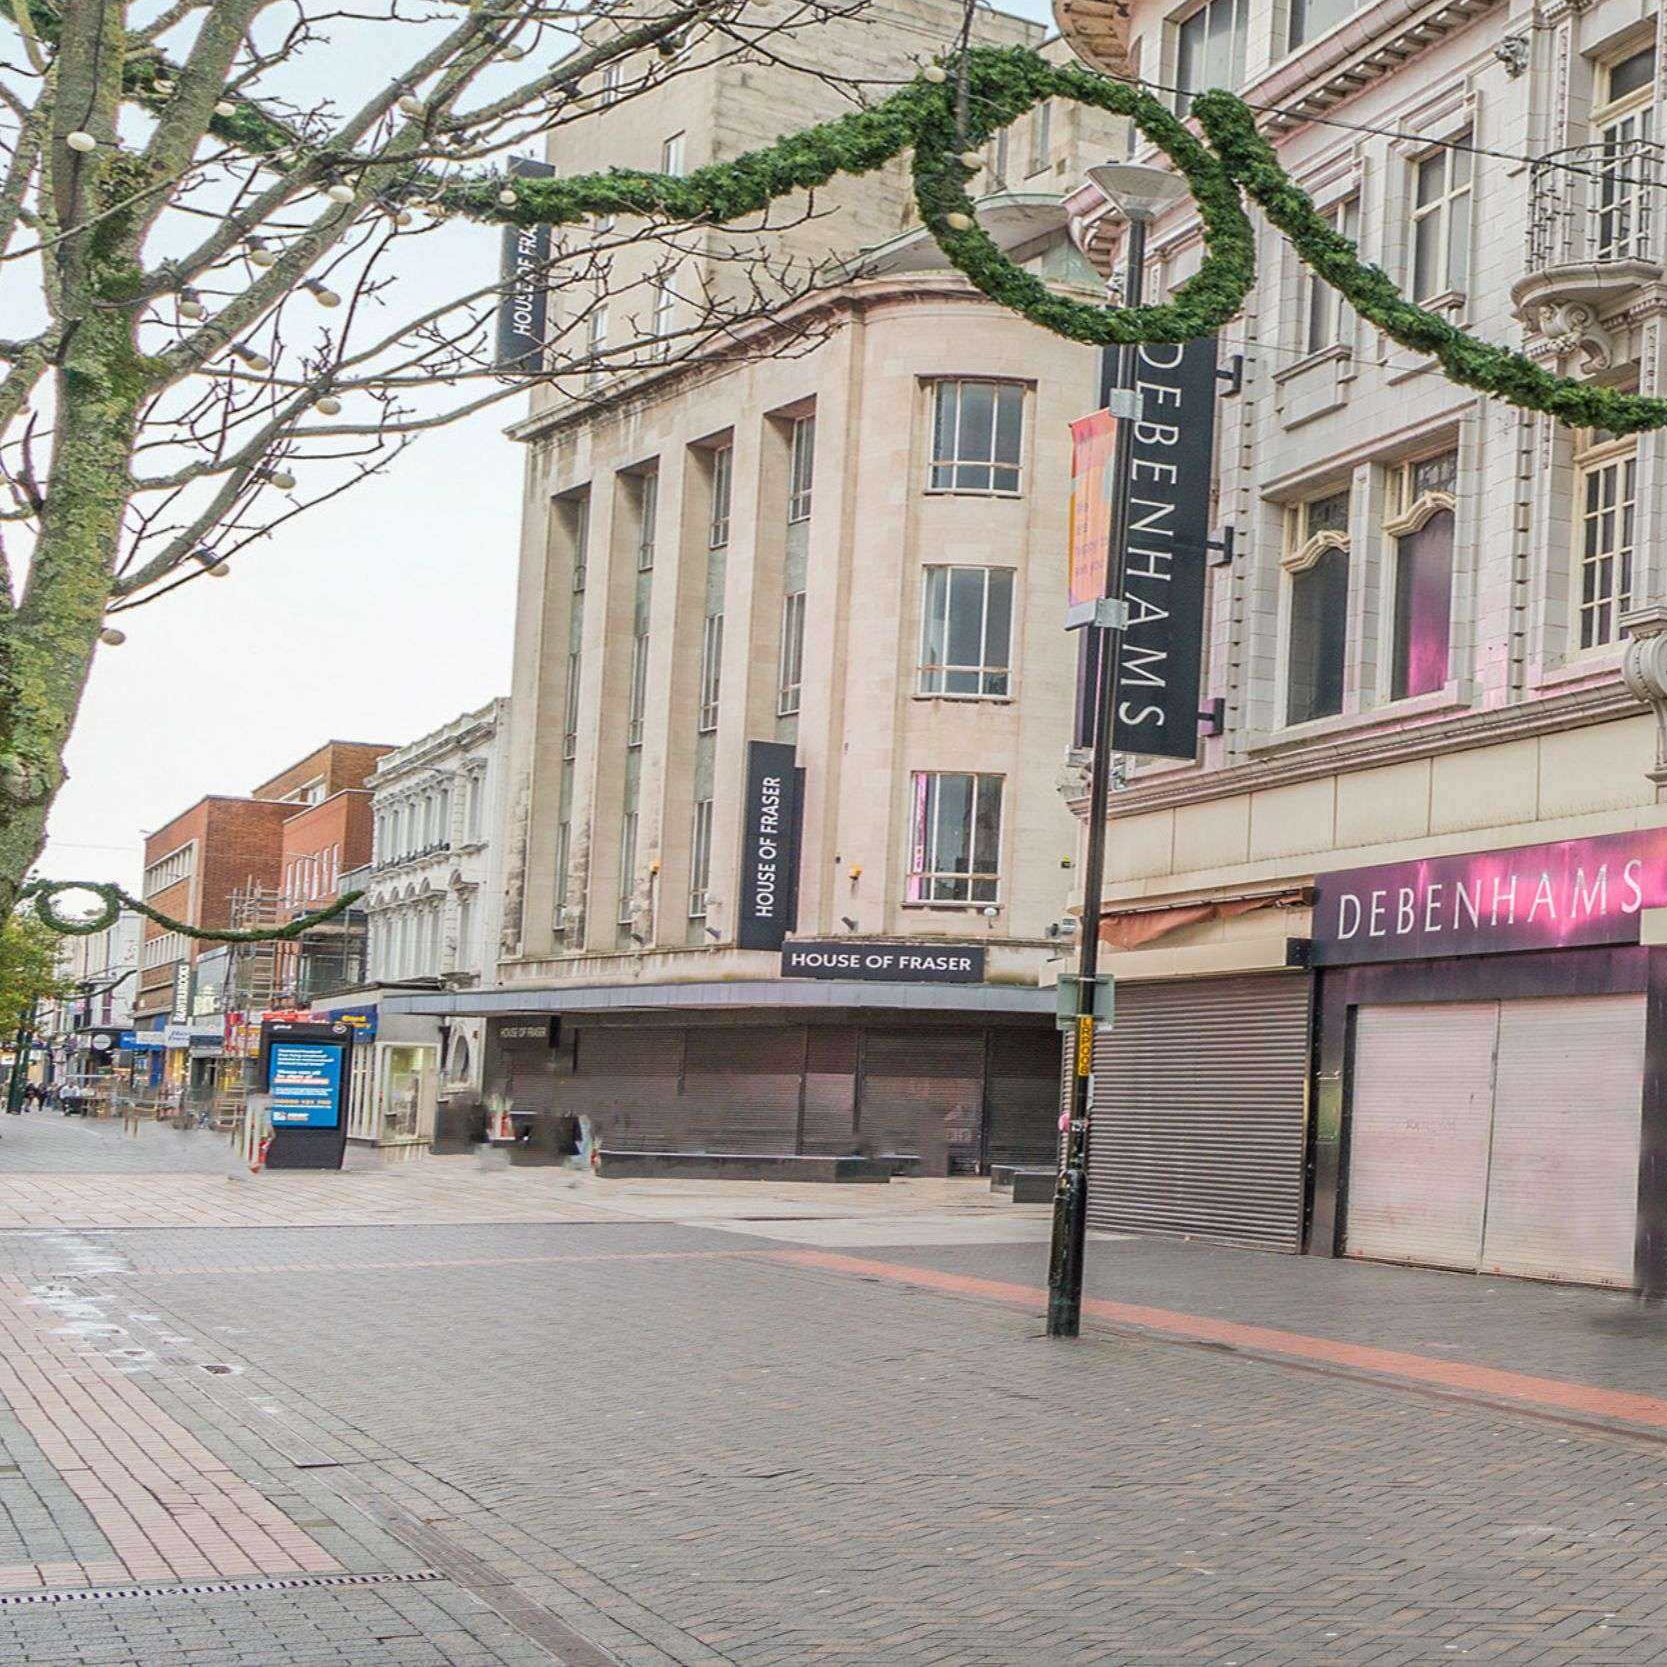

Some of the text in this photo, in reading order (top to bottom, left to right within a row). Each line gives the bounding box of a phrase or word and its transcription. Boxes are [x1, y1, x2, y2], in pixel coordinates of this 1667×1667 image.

[1118, 344, 1183, 726] DEBENHAMS
[755, 776, 781, 917] HOUSE OF FRASER
[1338, 858, 1643, 939] DEBENHAMS
[791, 953, 971, 971] HOUSE OF FRASER
